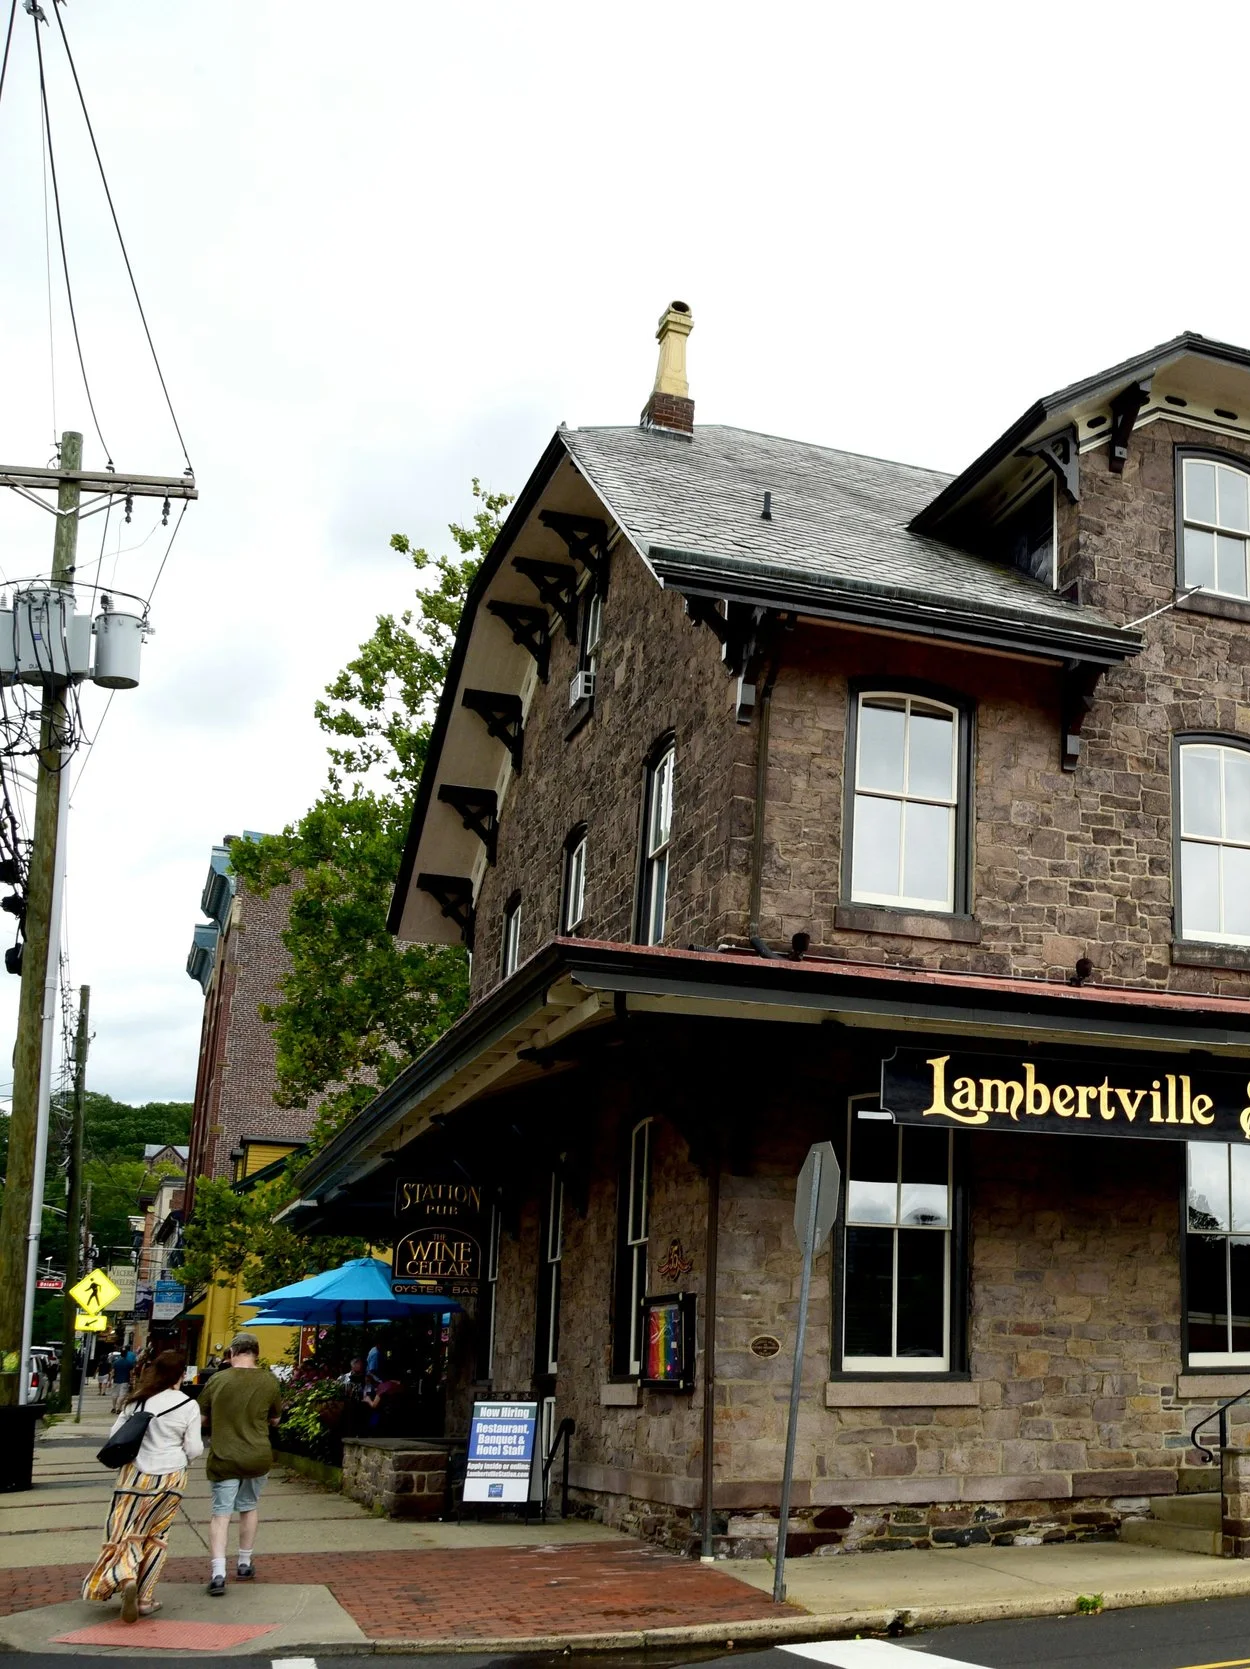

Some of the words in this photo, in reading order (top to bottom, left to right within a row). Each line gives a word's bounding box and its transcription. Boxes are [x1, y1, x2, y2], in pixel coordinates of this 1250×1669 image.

[923, 1055, 1214, 1124] Lambertville
[400, 1182, 482, 1213] STATION
[425, 1204, 459, 1215] PUB
[432, 1233, 448, 1241] THE
[407, 1240, 472, 1262] WINE
[406, 1260, 470, 1276] CELLAR
[394, 1285, 444, 1293] OYSTER
[452, 1286, 479, 1294] BAR
[480, 1407, 500, 1417] Now
[501, 1407, 530, 1419] Hiring
[476, 1423, 530, 1435] Restaurant,
[478, 1434, 517, 1446] Banquet
[518, 1435, 526, 1445] &
[476, 1445, 501, 1455] Hotel
[502, 1445, 526, 1456] Staff
[467, 1462, 484, 1471] Apply
